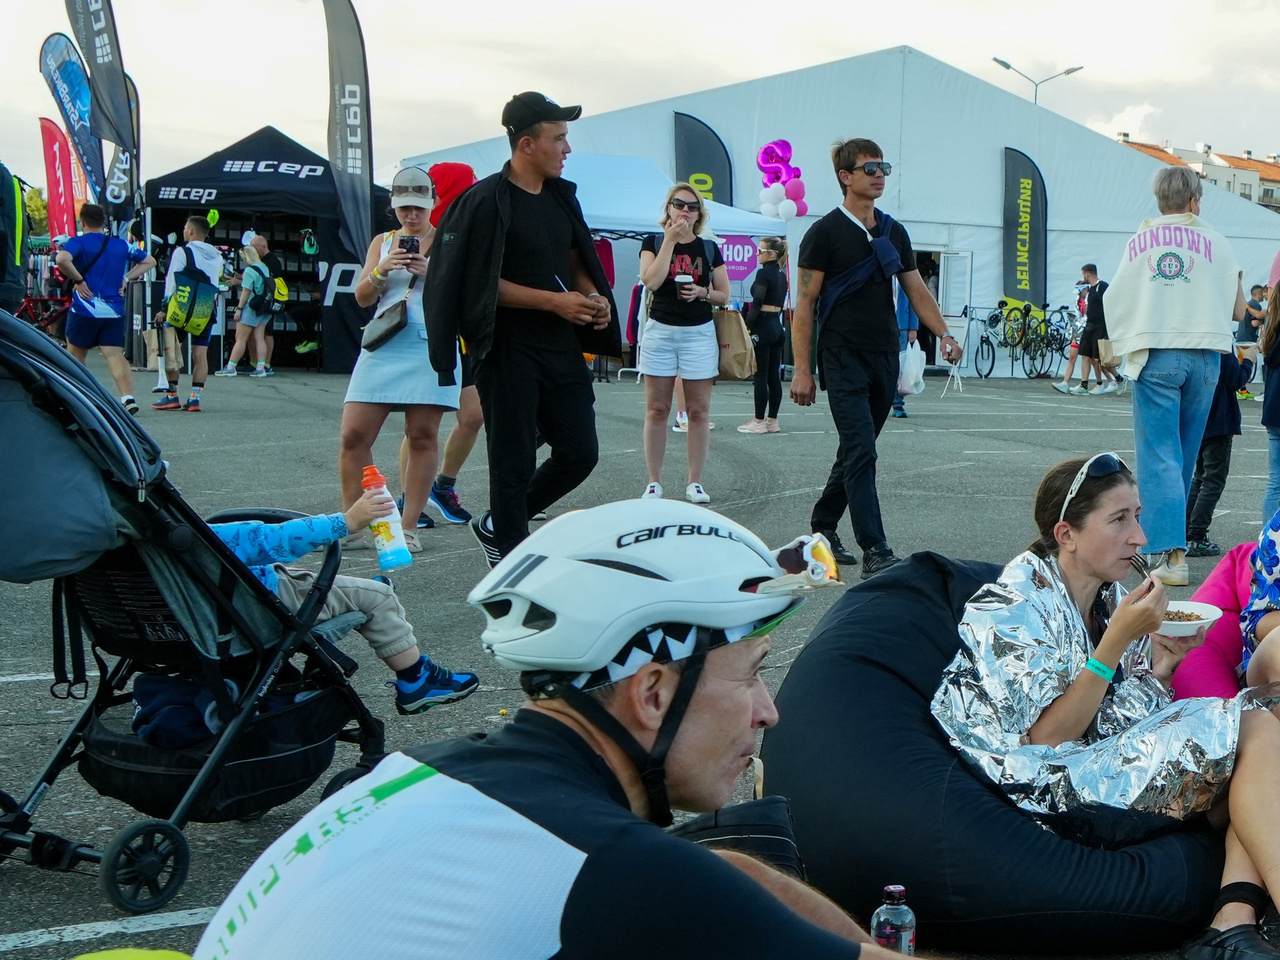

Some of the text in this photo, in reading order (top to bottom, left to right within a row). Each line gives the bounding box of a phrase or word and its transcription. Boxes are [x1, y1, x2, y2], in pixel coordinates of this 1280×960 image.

[178, 187, 218, 204] cep
[719, 244, 754, 263] HOP
[1128, 225, 1213, 264] RUNDOWN
